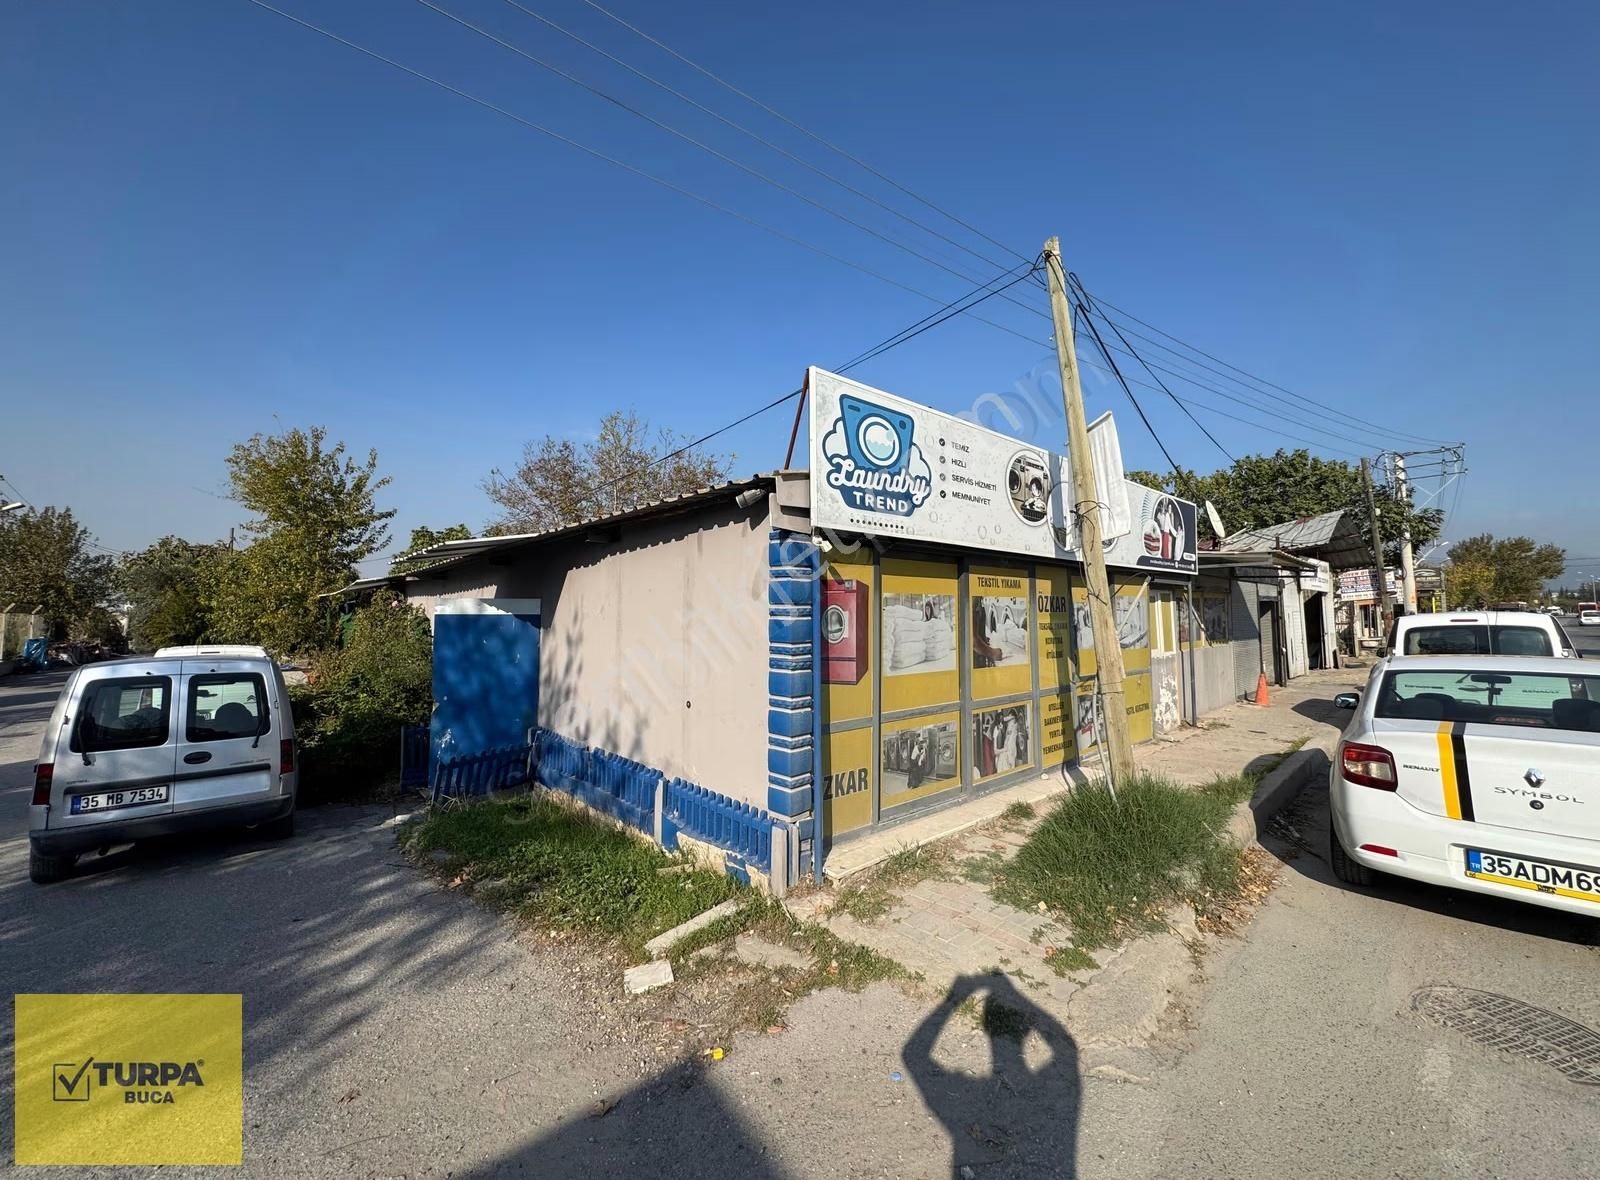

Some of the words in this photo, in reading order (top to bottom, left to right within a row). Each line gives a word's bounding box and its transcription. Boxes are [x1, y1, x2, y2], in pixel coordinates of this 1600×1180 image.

[829, 457, 930, 505] Laundry
[853, 491, 908, 513] TREND
[1001, 578, 1021, 589] YIKAMA
[1037, 591, 1067, 613] ÖZKAR
[1402, 764, 1440, 773] RENAULT
[823, 768, 868, 800] ZKAR
[81, 796, 99, 809] 35
[106, 793, 124, 805] MB
[130, 788, 163, 803] 7534
[1494, 786, 1585, 805] SYMBOL
